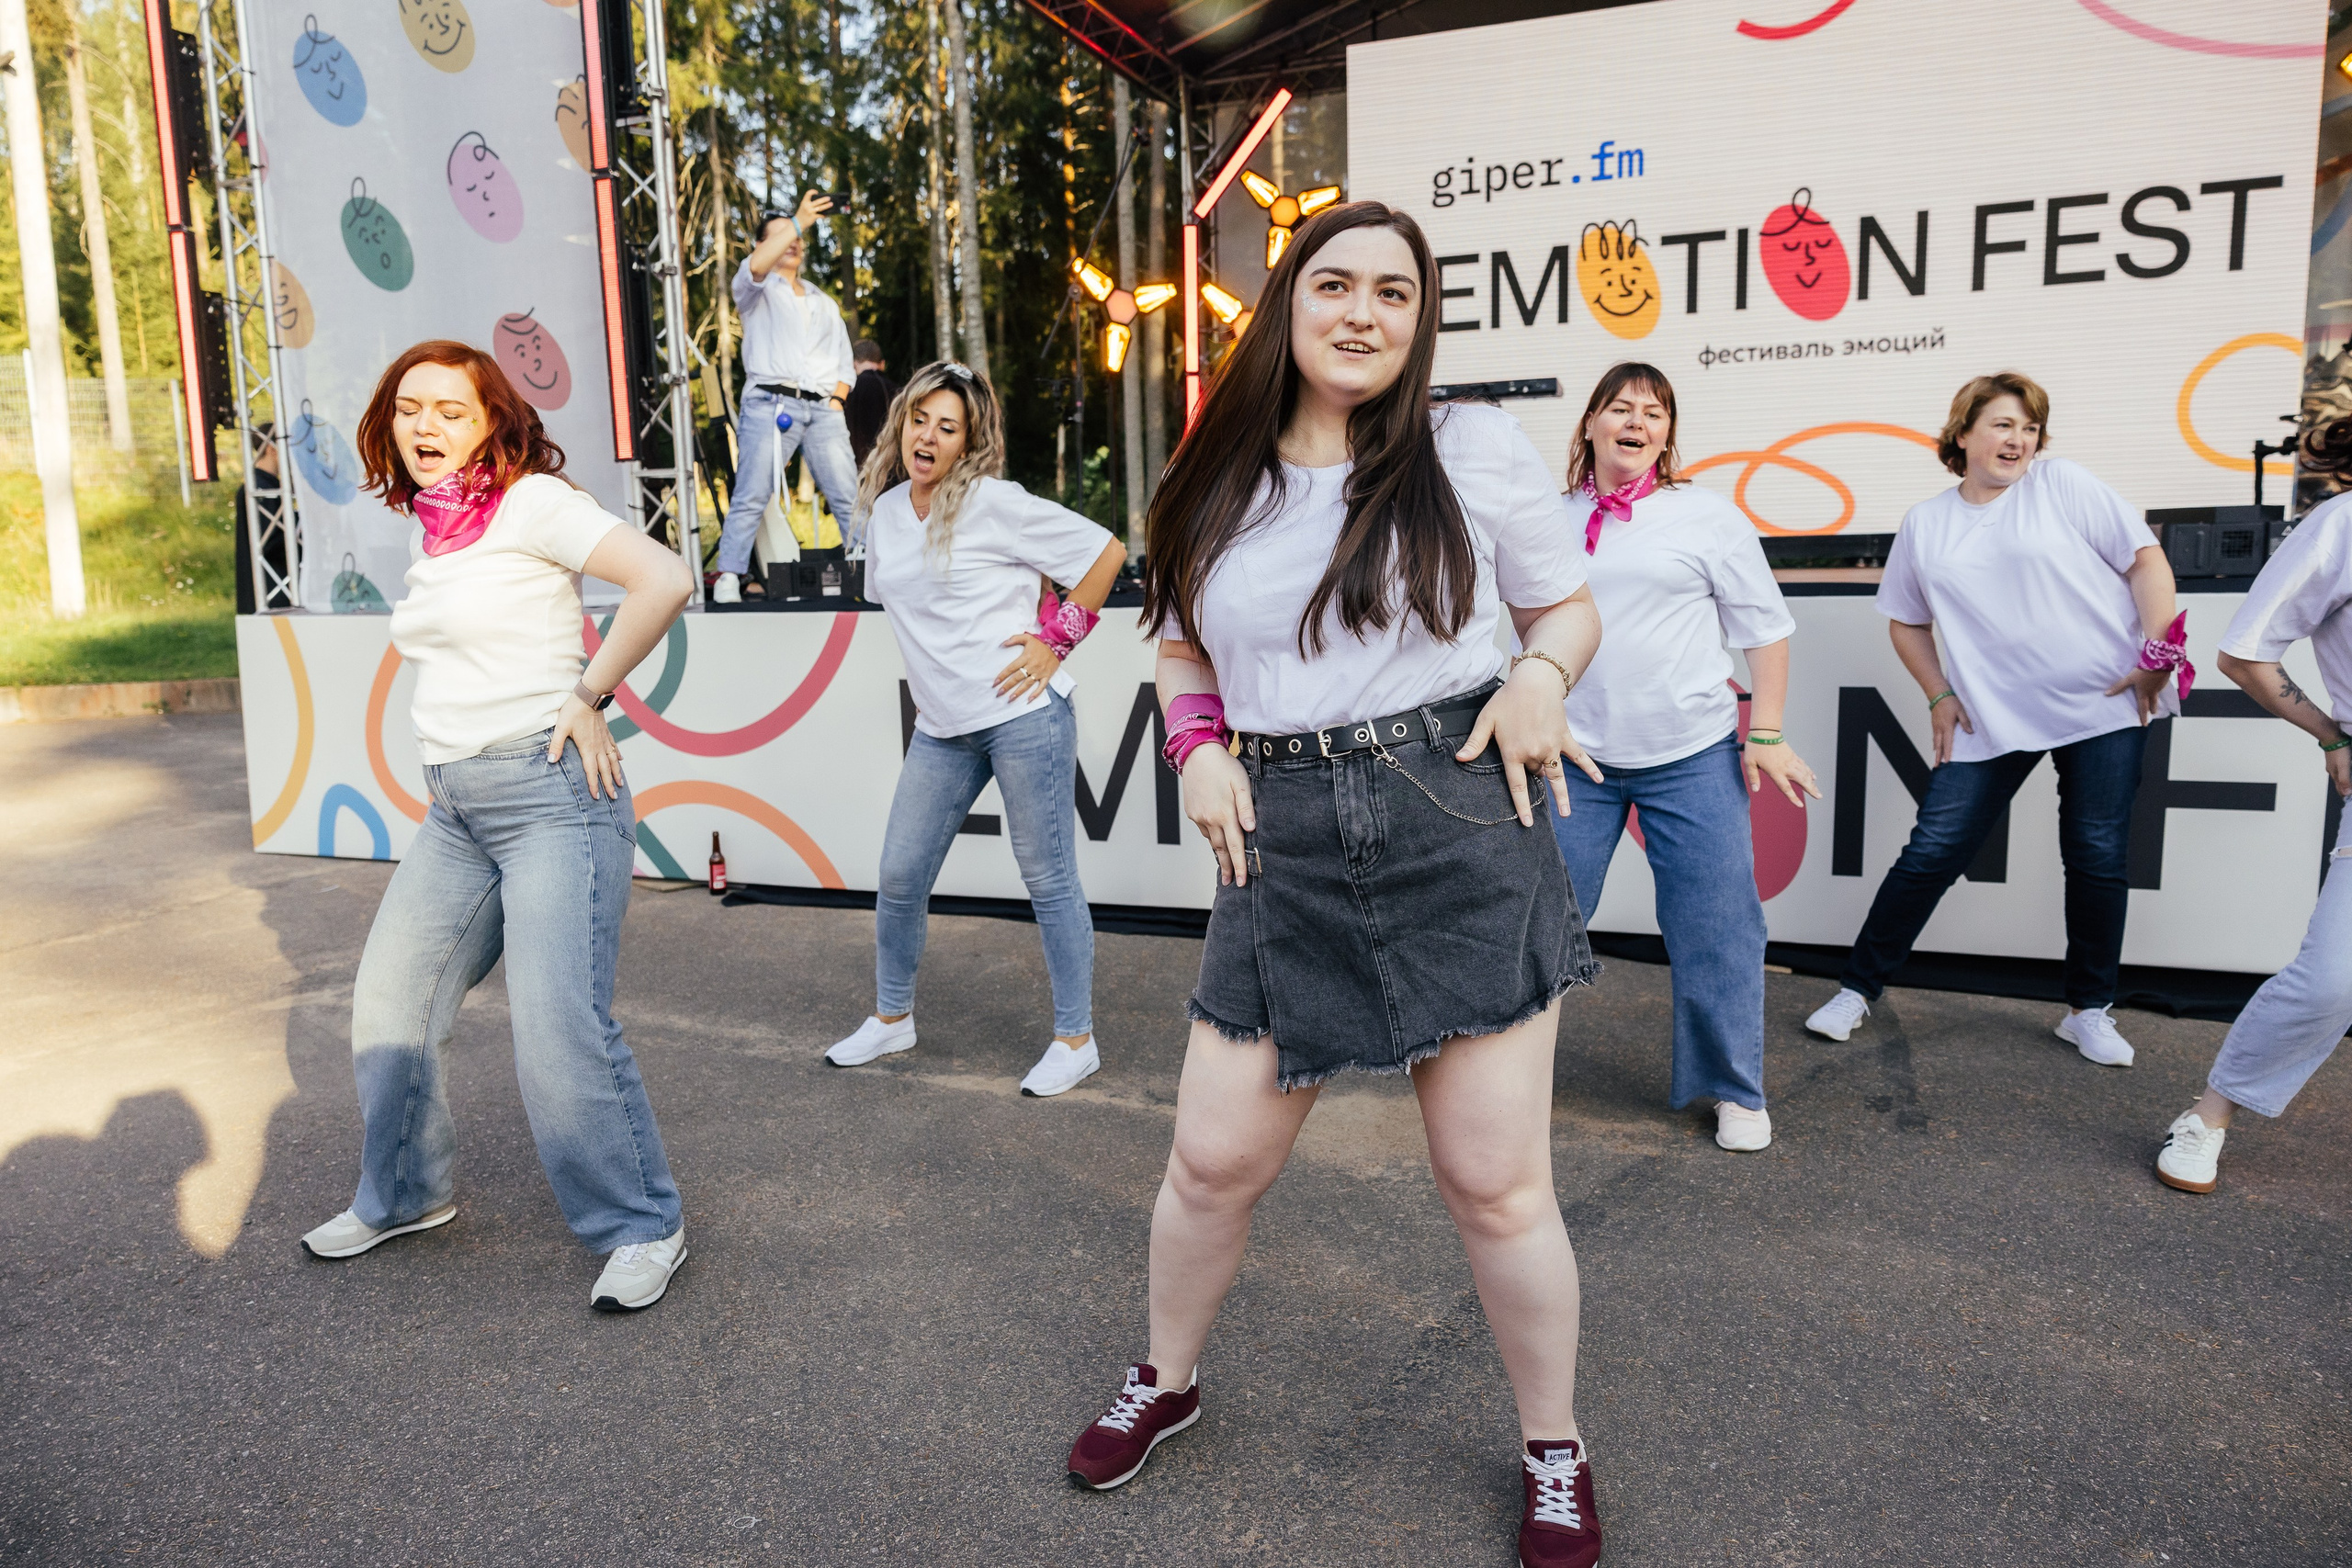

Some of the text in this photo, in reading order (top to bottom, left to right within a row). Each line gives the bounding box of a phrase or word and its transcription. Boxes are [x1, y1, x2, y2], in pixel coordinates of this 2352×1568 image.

[1432, 141, 1645, 208] giper.fm
[1972, 175, 2284, 292] FEST
[1699, 327, 1946, 370] фестиваль эмоций
